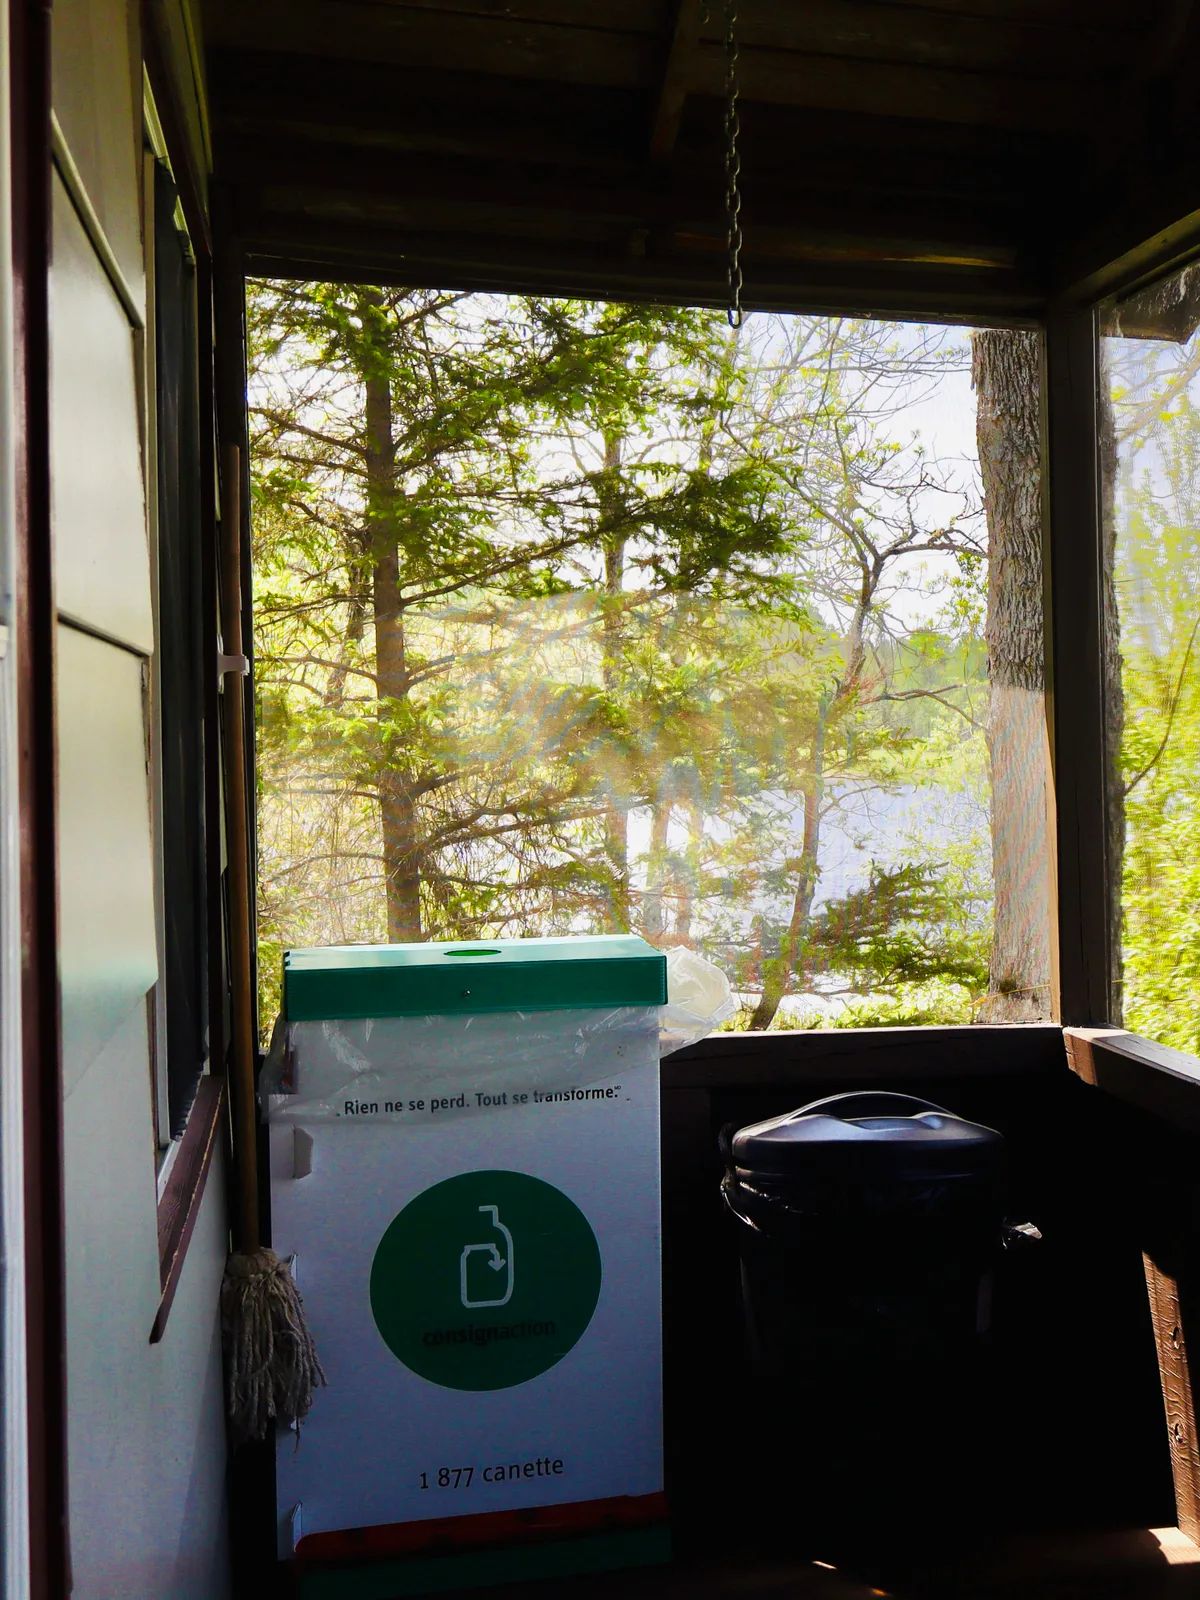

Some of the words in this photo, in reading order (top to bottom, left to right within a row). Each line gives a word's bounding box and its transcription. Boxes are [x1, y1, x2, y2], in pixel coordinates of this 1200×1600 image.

[344, 1100, 378, 1116] Rien
[384, 1098, 403, 1113] ne
[408, 1096, 425, 1111] se
[430, 1092, 470, 1114] perd.
[475, 1091, 508, 1107] Tout
[512, 1091, 529, 1105] se
[422, 1320, 556, 1347] consignaction
[420, 1472, 429, 1489] 1
[438, 1467, 474, 1489] 877
[482, 1457, 564, 1482] canette
